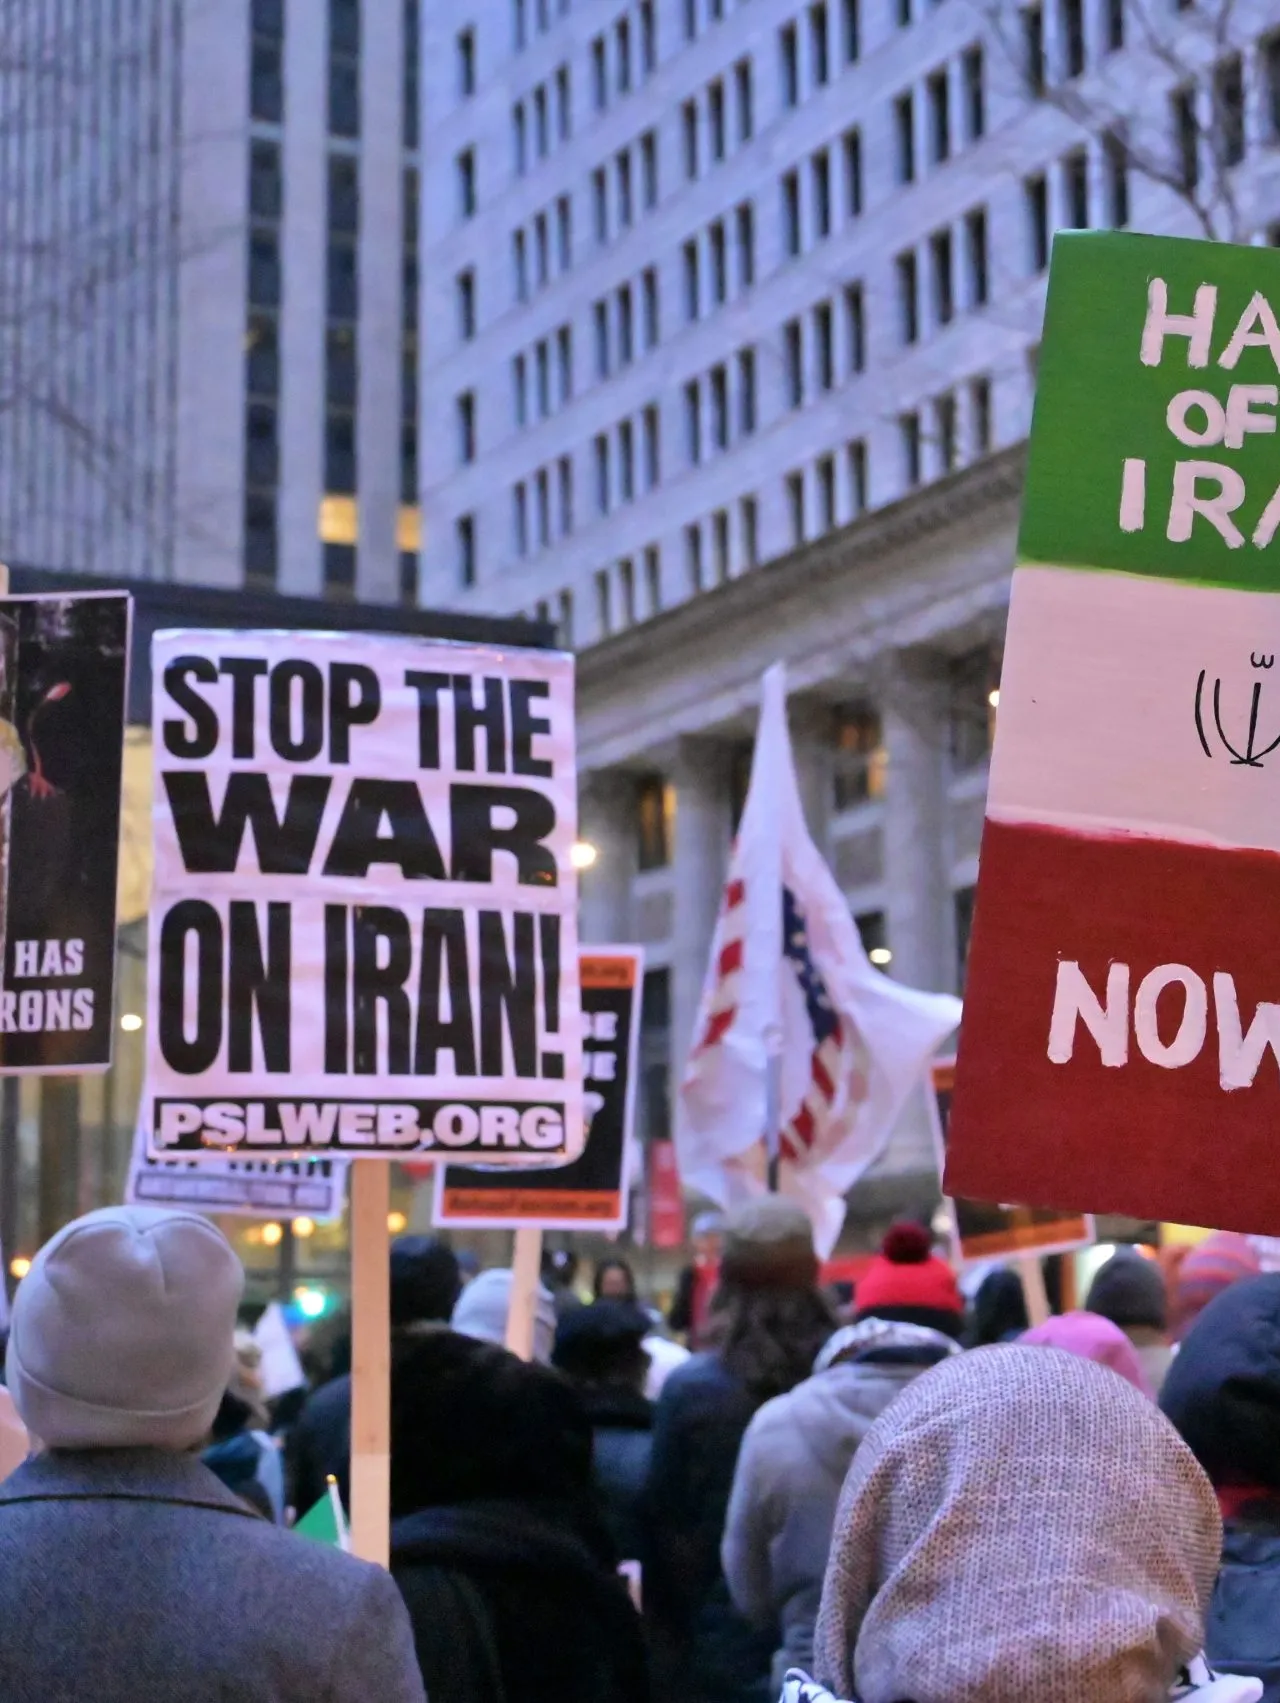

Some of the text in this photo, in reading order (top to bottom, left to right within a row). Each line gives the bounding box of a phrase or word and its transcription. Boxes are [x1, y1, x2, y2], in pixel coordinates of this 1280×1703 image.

[162, 655, 554, 779] STOP THE
[161, 770, 558, 888] WAR
[14, 938, 85, 977] HAS
[159, 898, 565, 1080] ON IRAN!
[158, 1102, 564, 1149] PSLWEB.ORG
